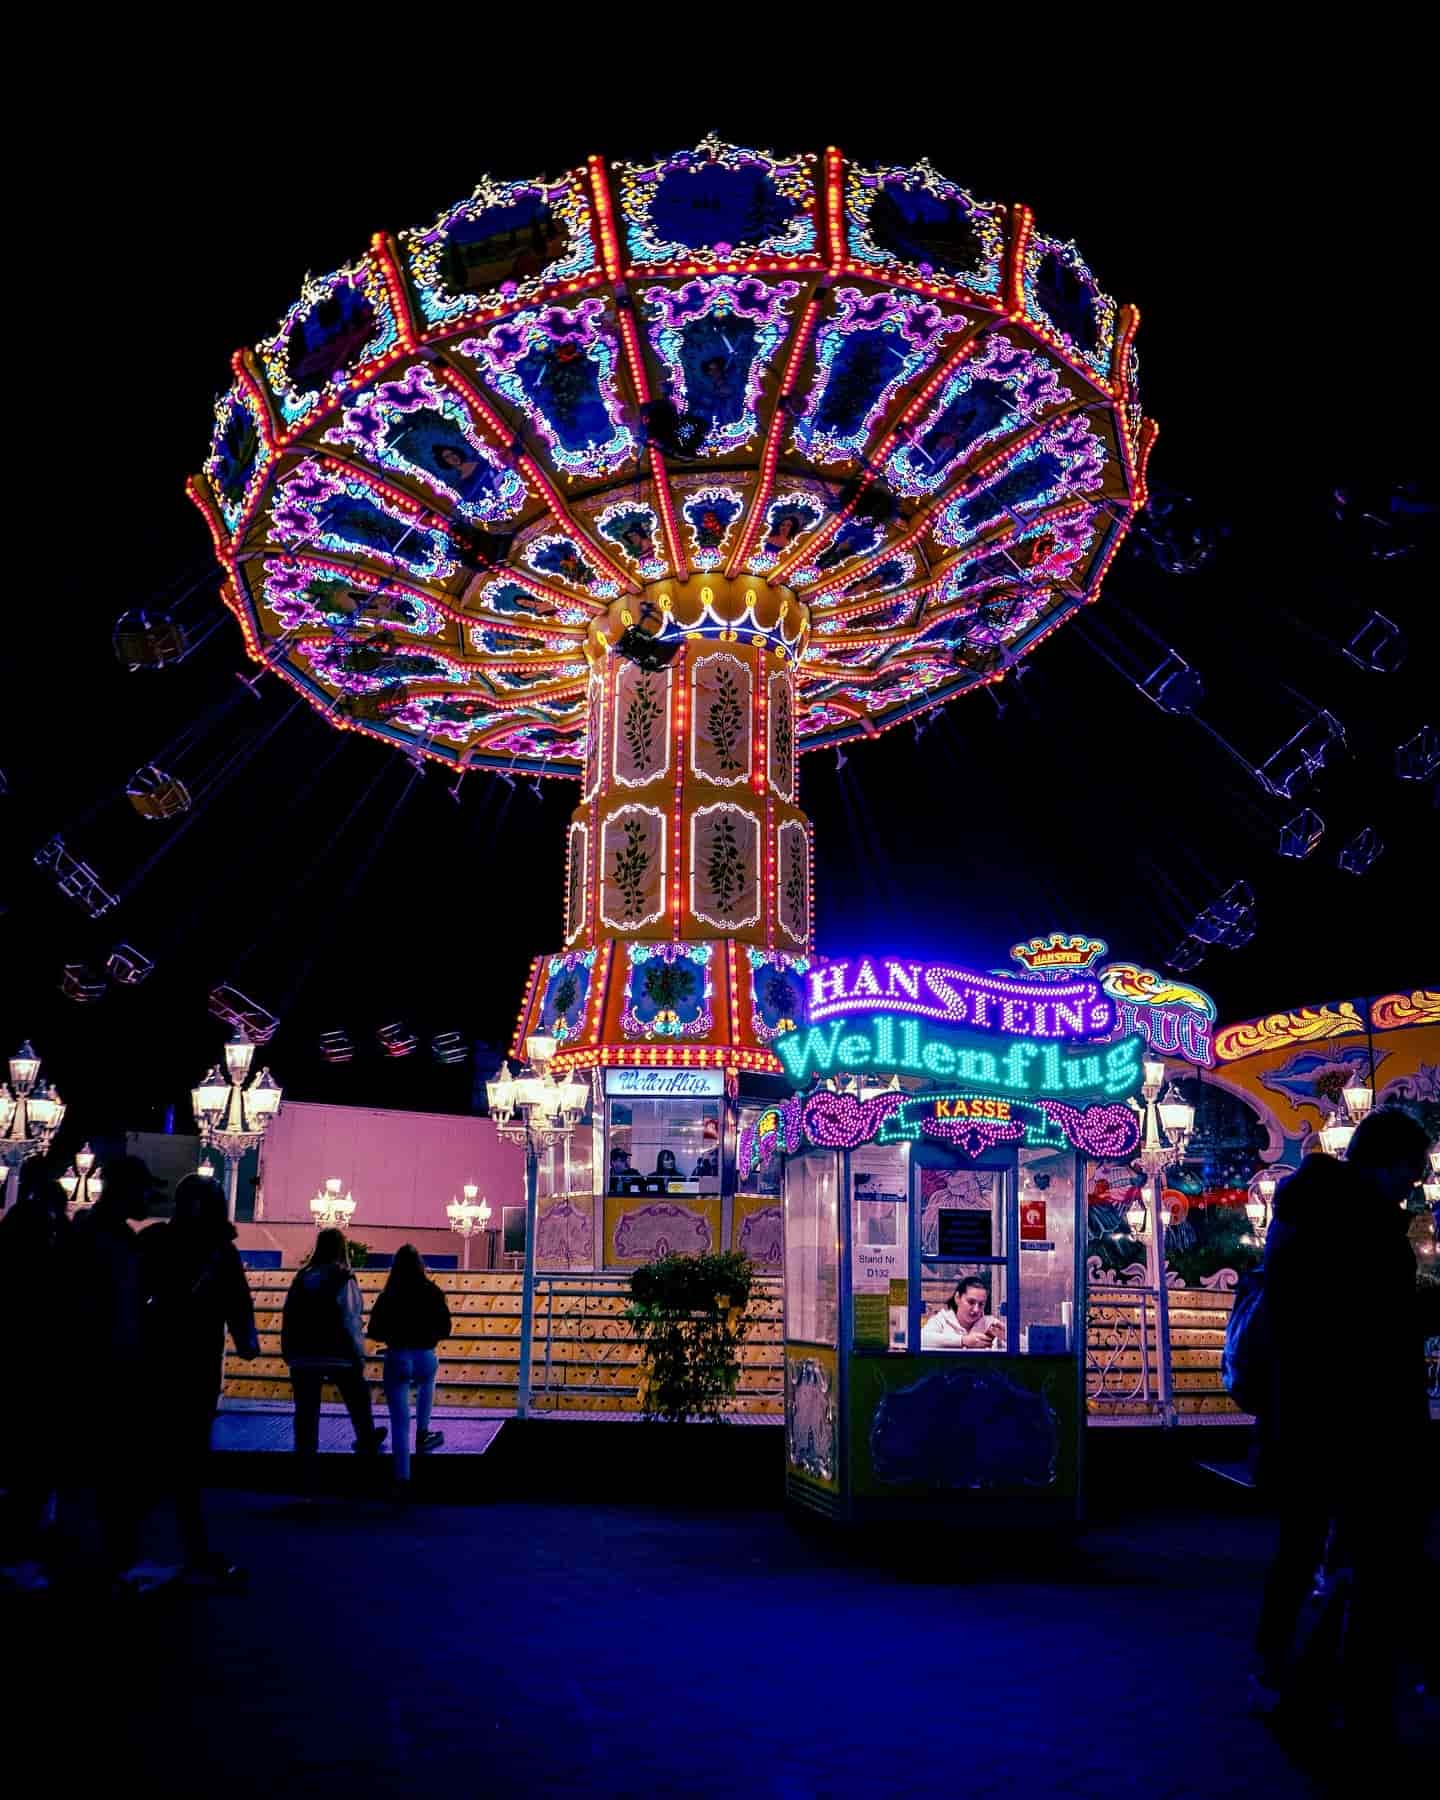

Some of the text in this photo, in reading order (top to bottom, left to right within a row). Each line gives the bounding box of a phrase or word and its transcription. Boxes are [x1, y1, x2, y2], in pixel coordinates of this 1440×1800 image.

[777, 1016, 1143, 1094] Wellenflug
[936, 1099, 1011, 1120] KASSE
[859, 1255, 883, 1264] Stand
